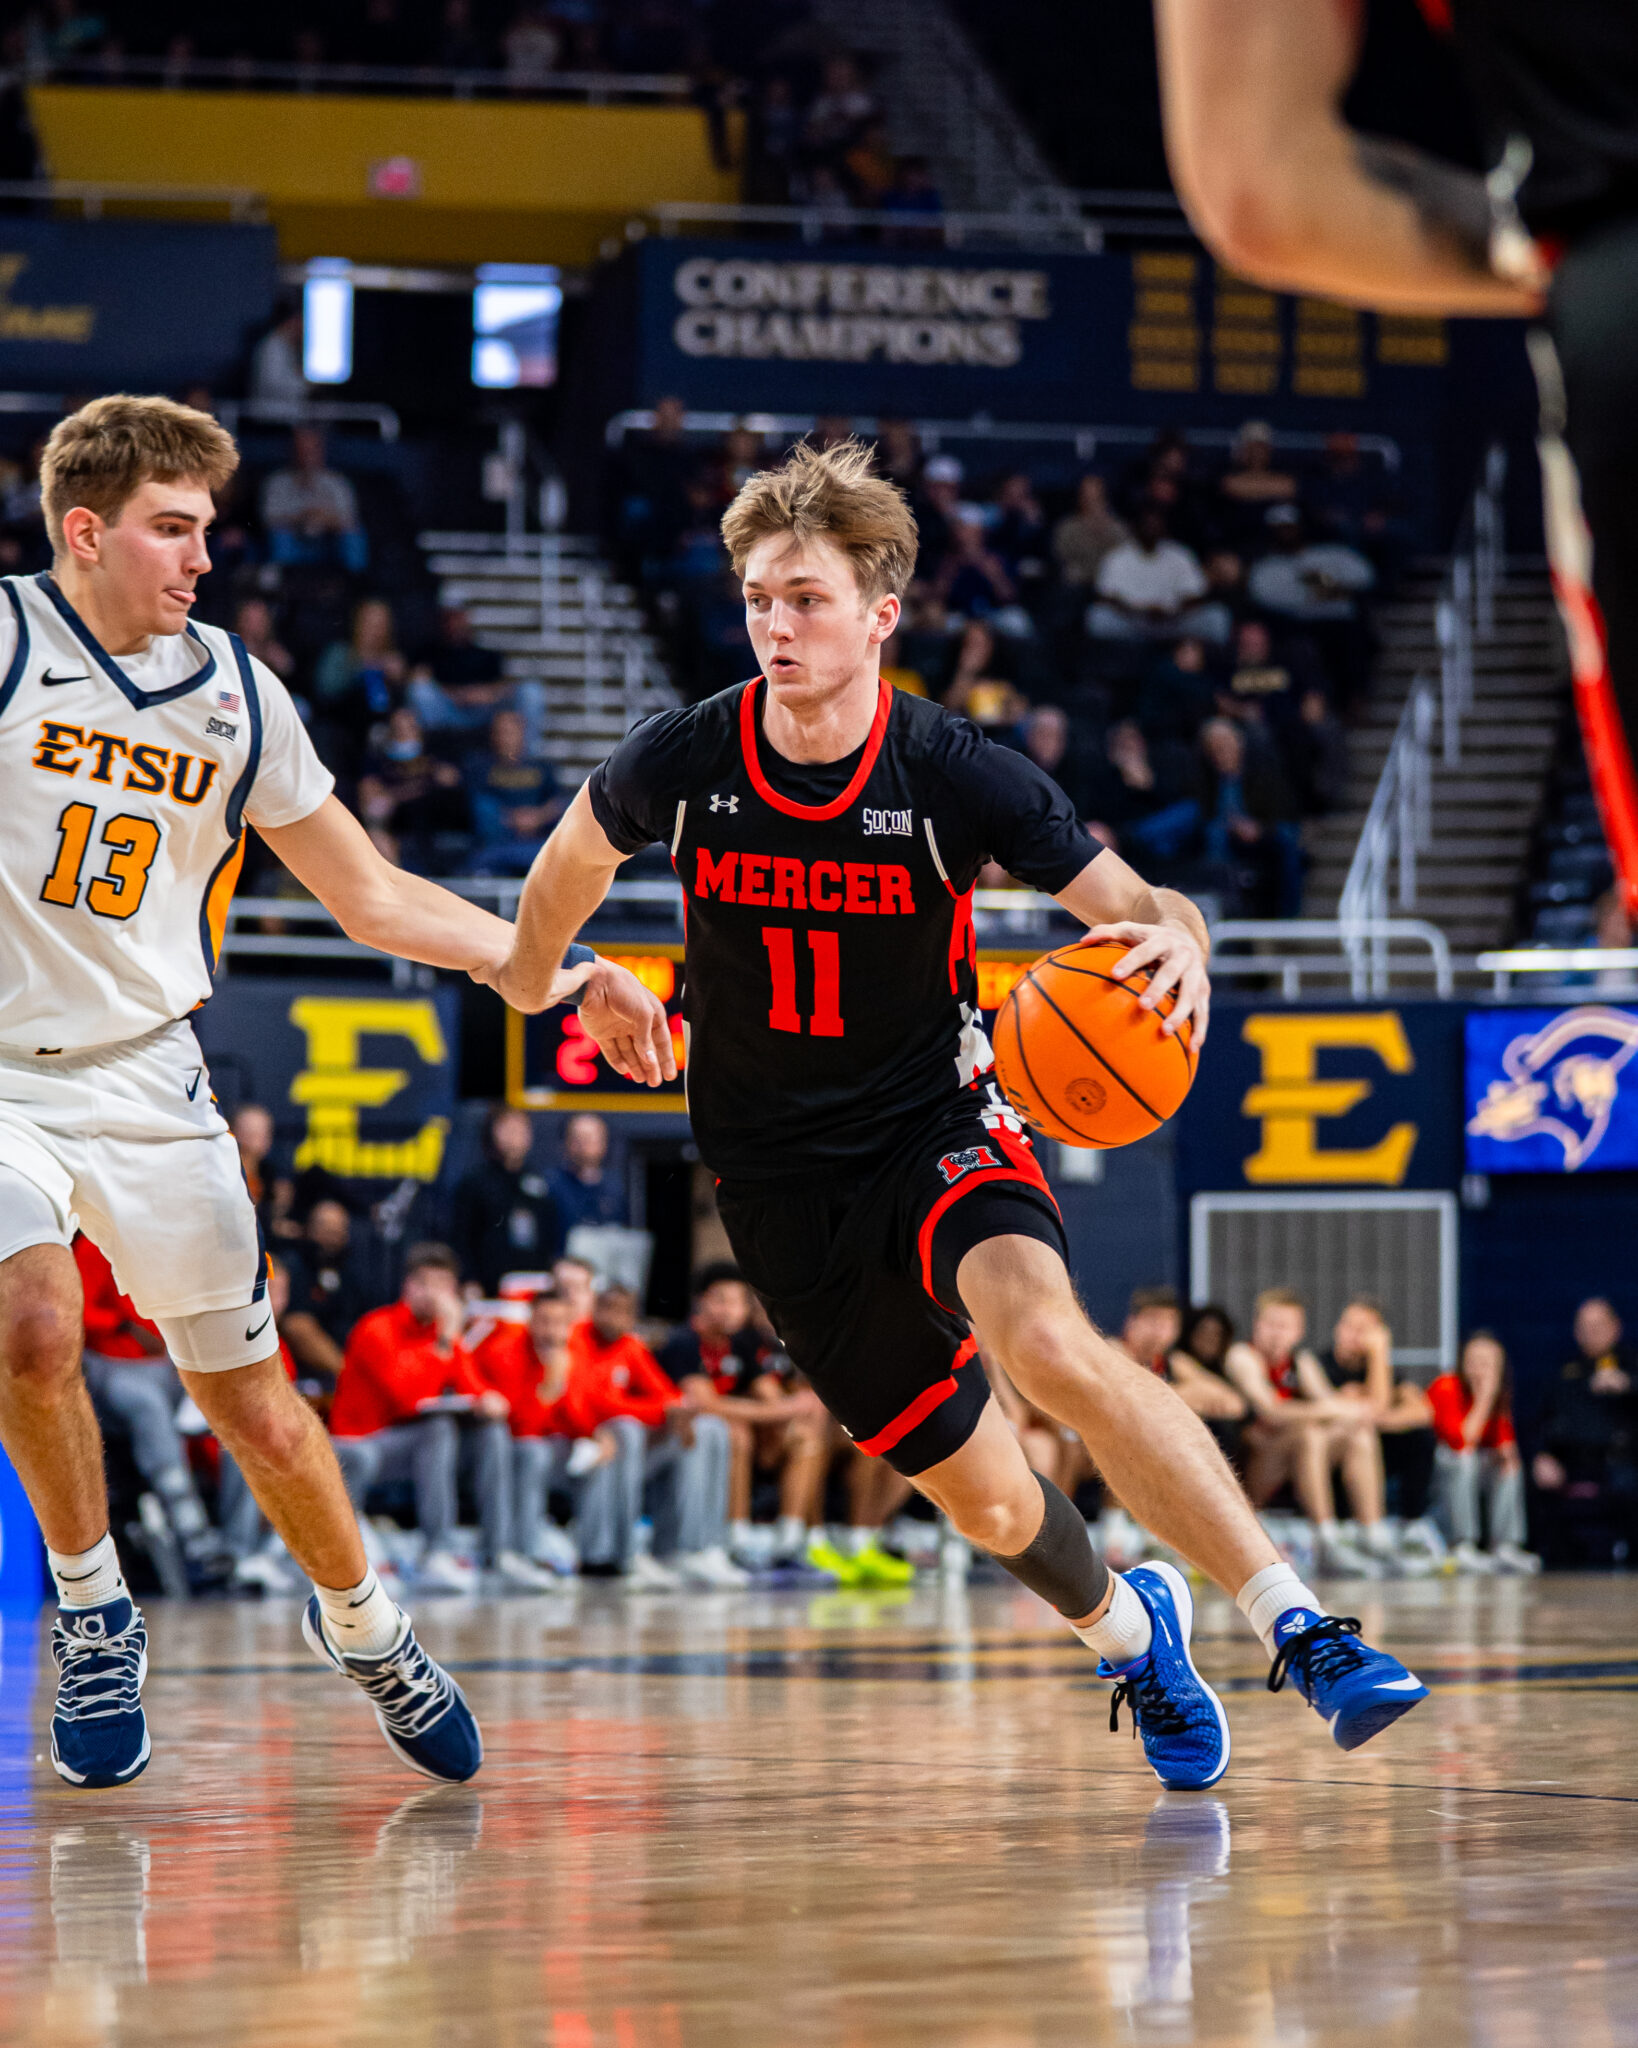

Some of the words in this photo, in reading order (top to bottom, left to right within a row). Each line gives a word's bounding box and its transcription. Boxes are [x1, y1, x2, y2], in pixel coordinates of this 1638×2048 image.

[675, 258, 1049, 318] CONFERENCE
[675, 309, 1021, 366] CHAMPIONS
[33, 720, 218, 806] ETSU
[40, 801, 162, 920] 13
[863, 808, 913, 836] SOCON
[694, 847, 916, 915] MERCER
[762, 927, 844, 1037] 11
[289, 996, 450, 1181] E
[1242, 1012, 1417, 1184] E
